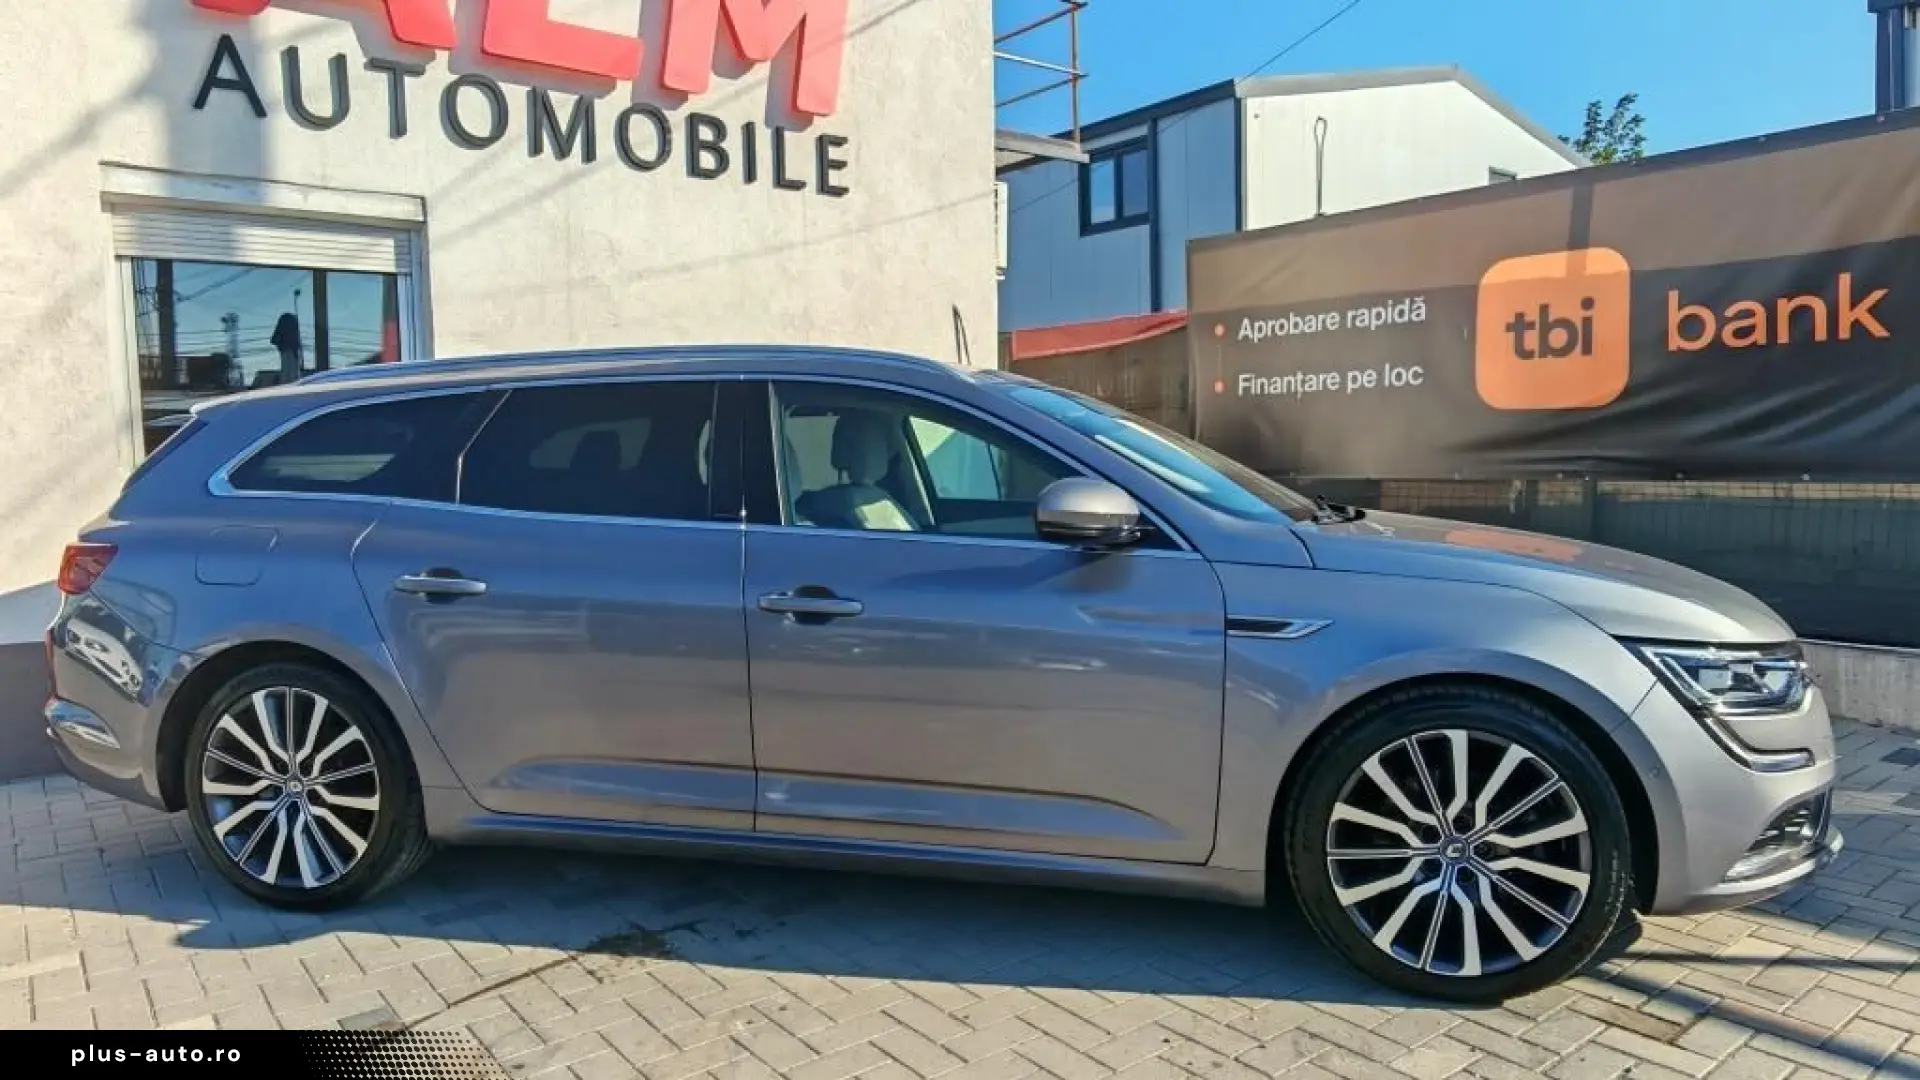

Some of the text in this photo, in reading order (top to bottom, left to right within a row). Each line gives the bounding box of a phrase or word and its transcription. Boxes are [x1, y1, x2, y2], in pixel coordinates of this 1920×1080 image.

[193, 33, 850, 197] AUTOMOBILE
[1238, 296, 1427, 343] Aprobare rapidă
[1505, 271, 1892, 361] tbi bank
[1237, 363, 1425, 401] Finanțare pe loc
